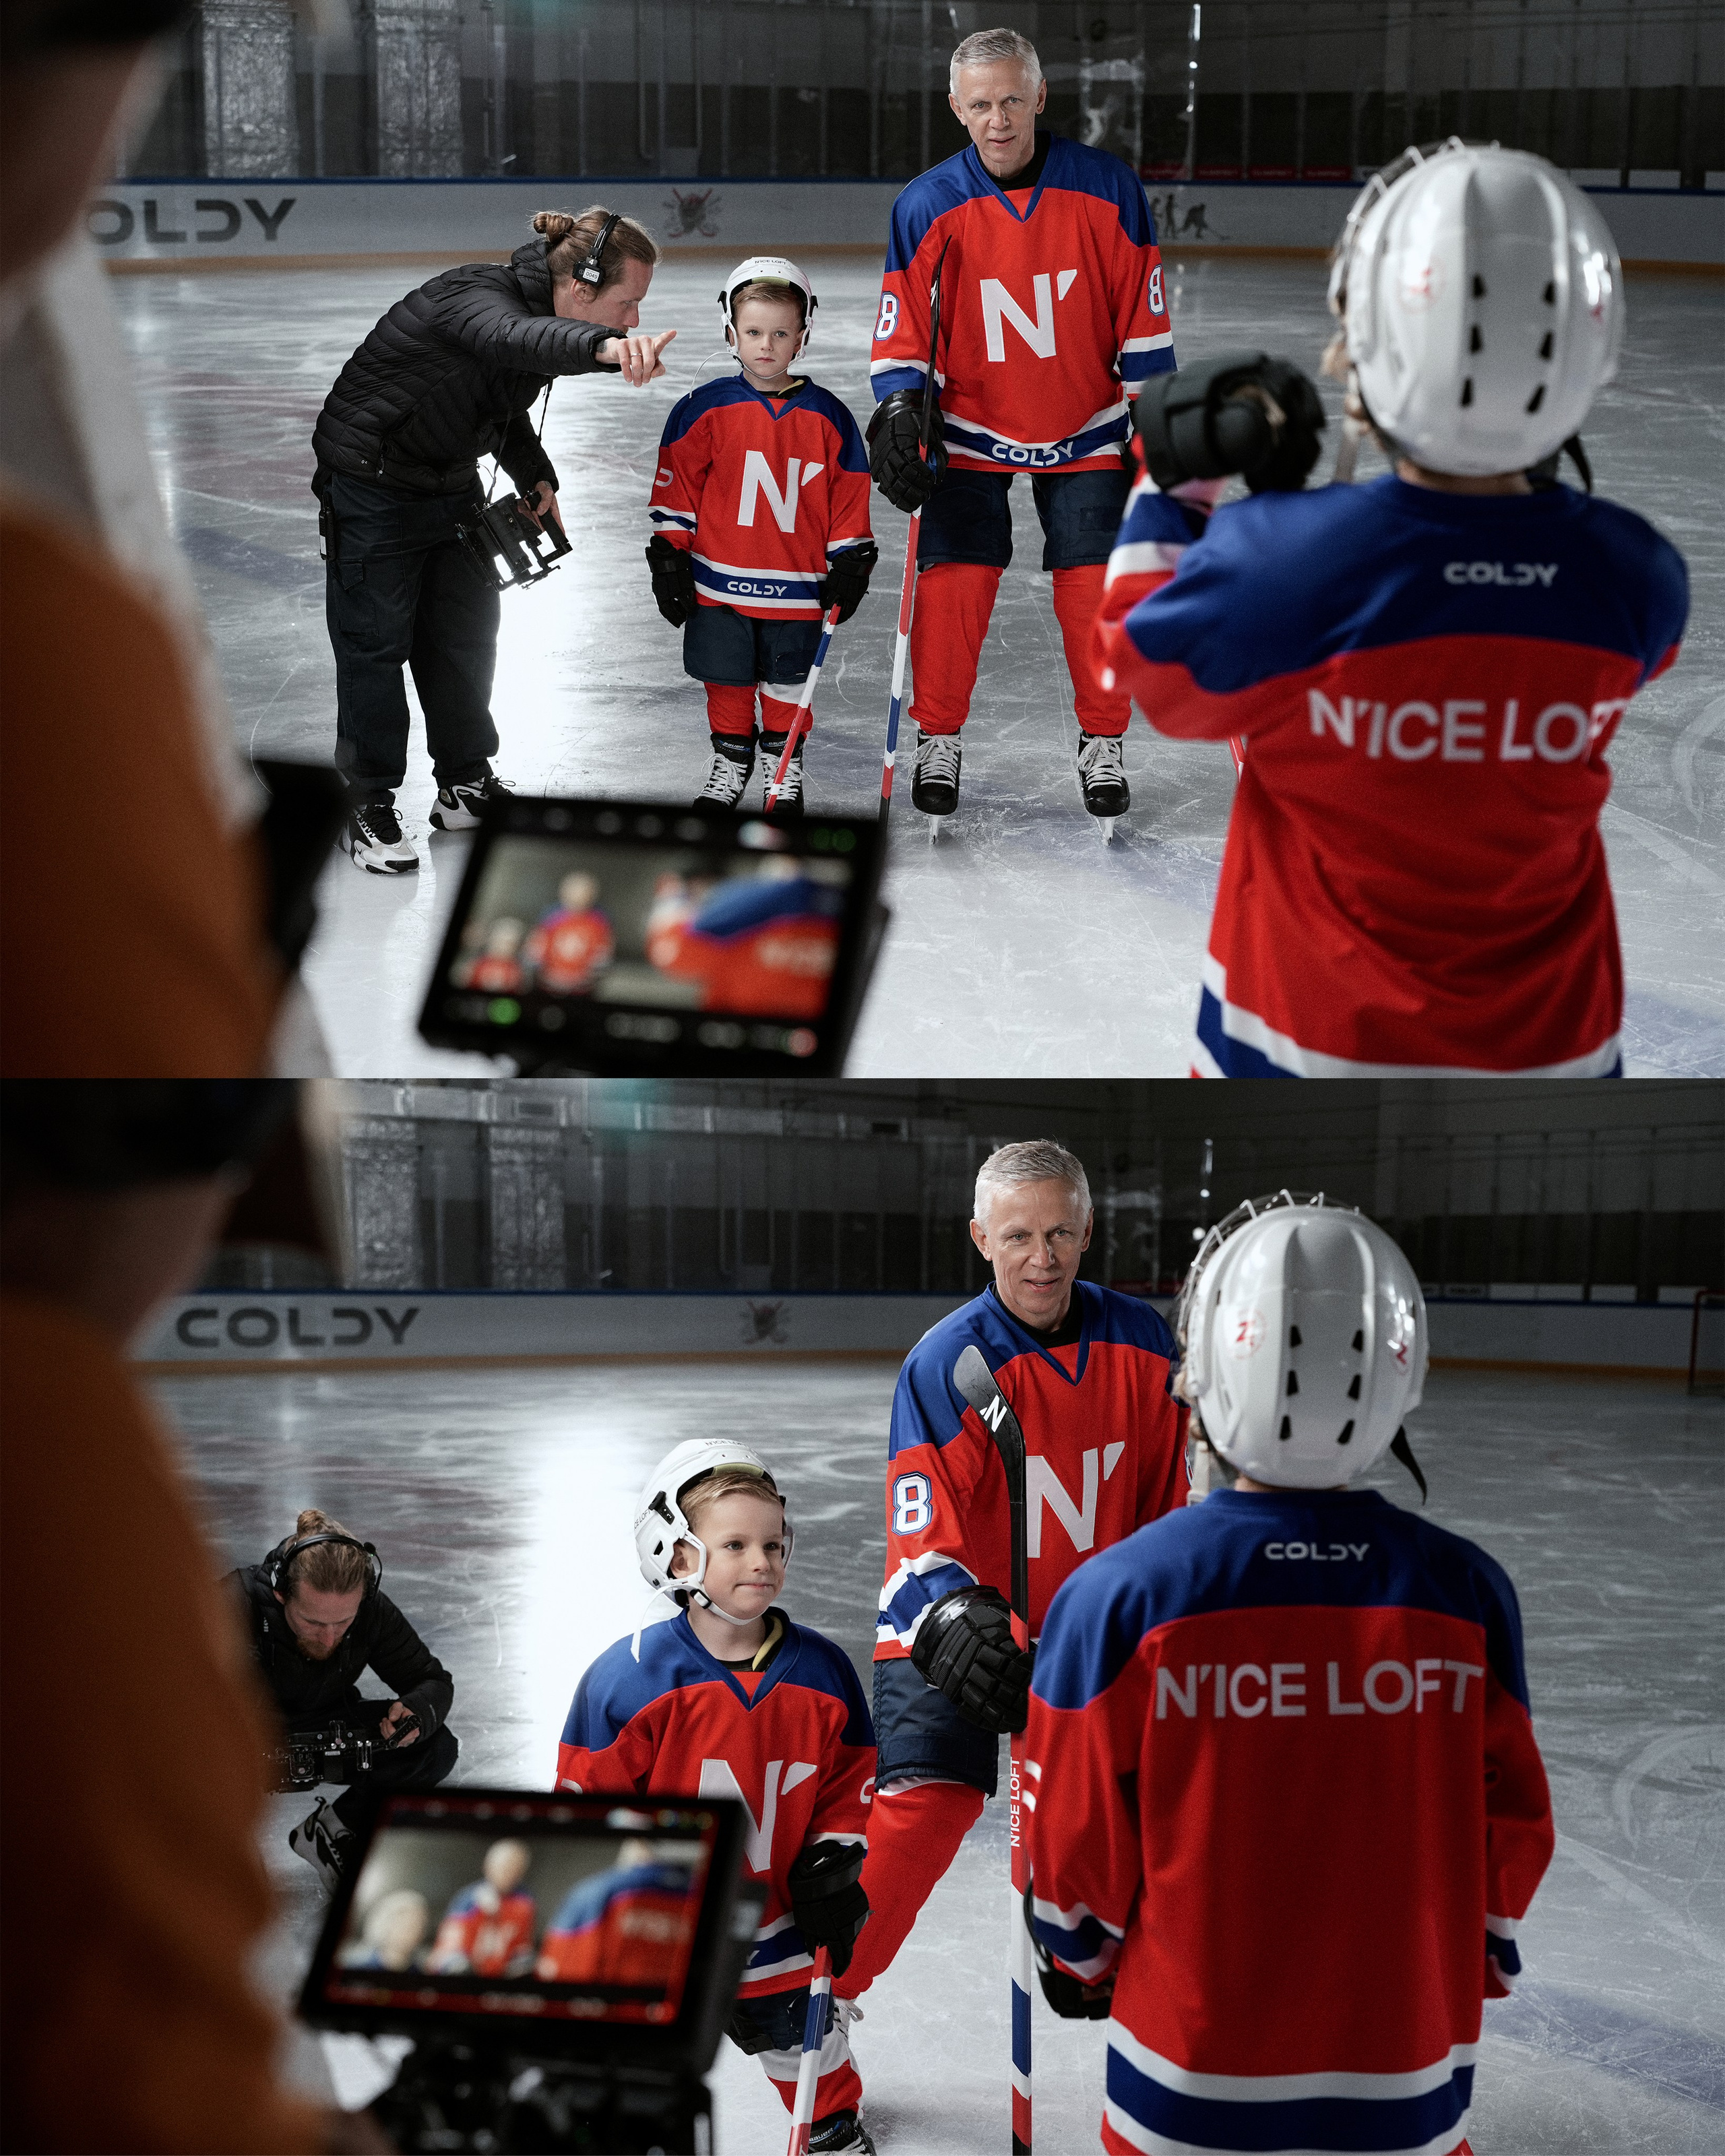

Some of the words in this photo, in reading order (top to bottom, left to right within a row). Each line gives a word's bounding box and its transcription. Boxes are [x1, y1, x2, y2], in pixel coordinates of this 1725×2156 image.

[86, 198, 296, 245] OLDY
[586, 271, 598, 280] 0049
[1149, 263, 1166, 317] 8
[874, 291, 900, 341] 8
[992, 441, 1073, 467] COLDY
[727, 581, 788, 598] COLDY
[1443, 561, 1559, 588] COLDY
[176, 1306, 420, 1348] COLDY
[891, 1471, 933, 1536] 8
[1265, 1542, 1371, 1562] COLDY
[1327, 1658, 1485, 1715] LOFT
[1010, 1756, 1020, 1800] LOFT
